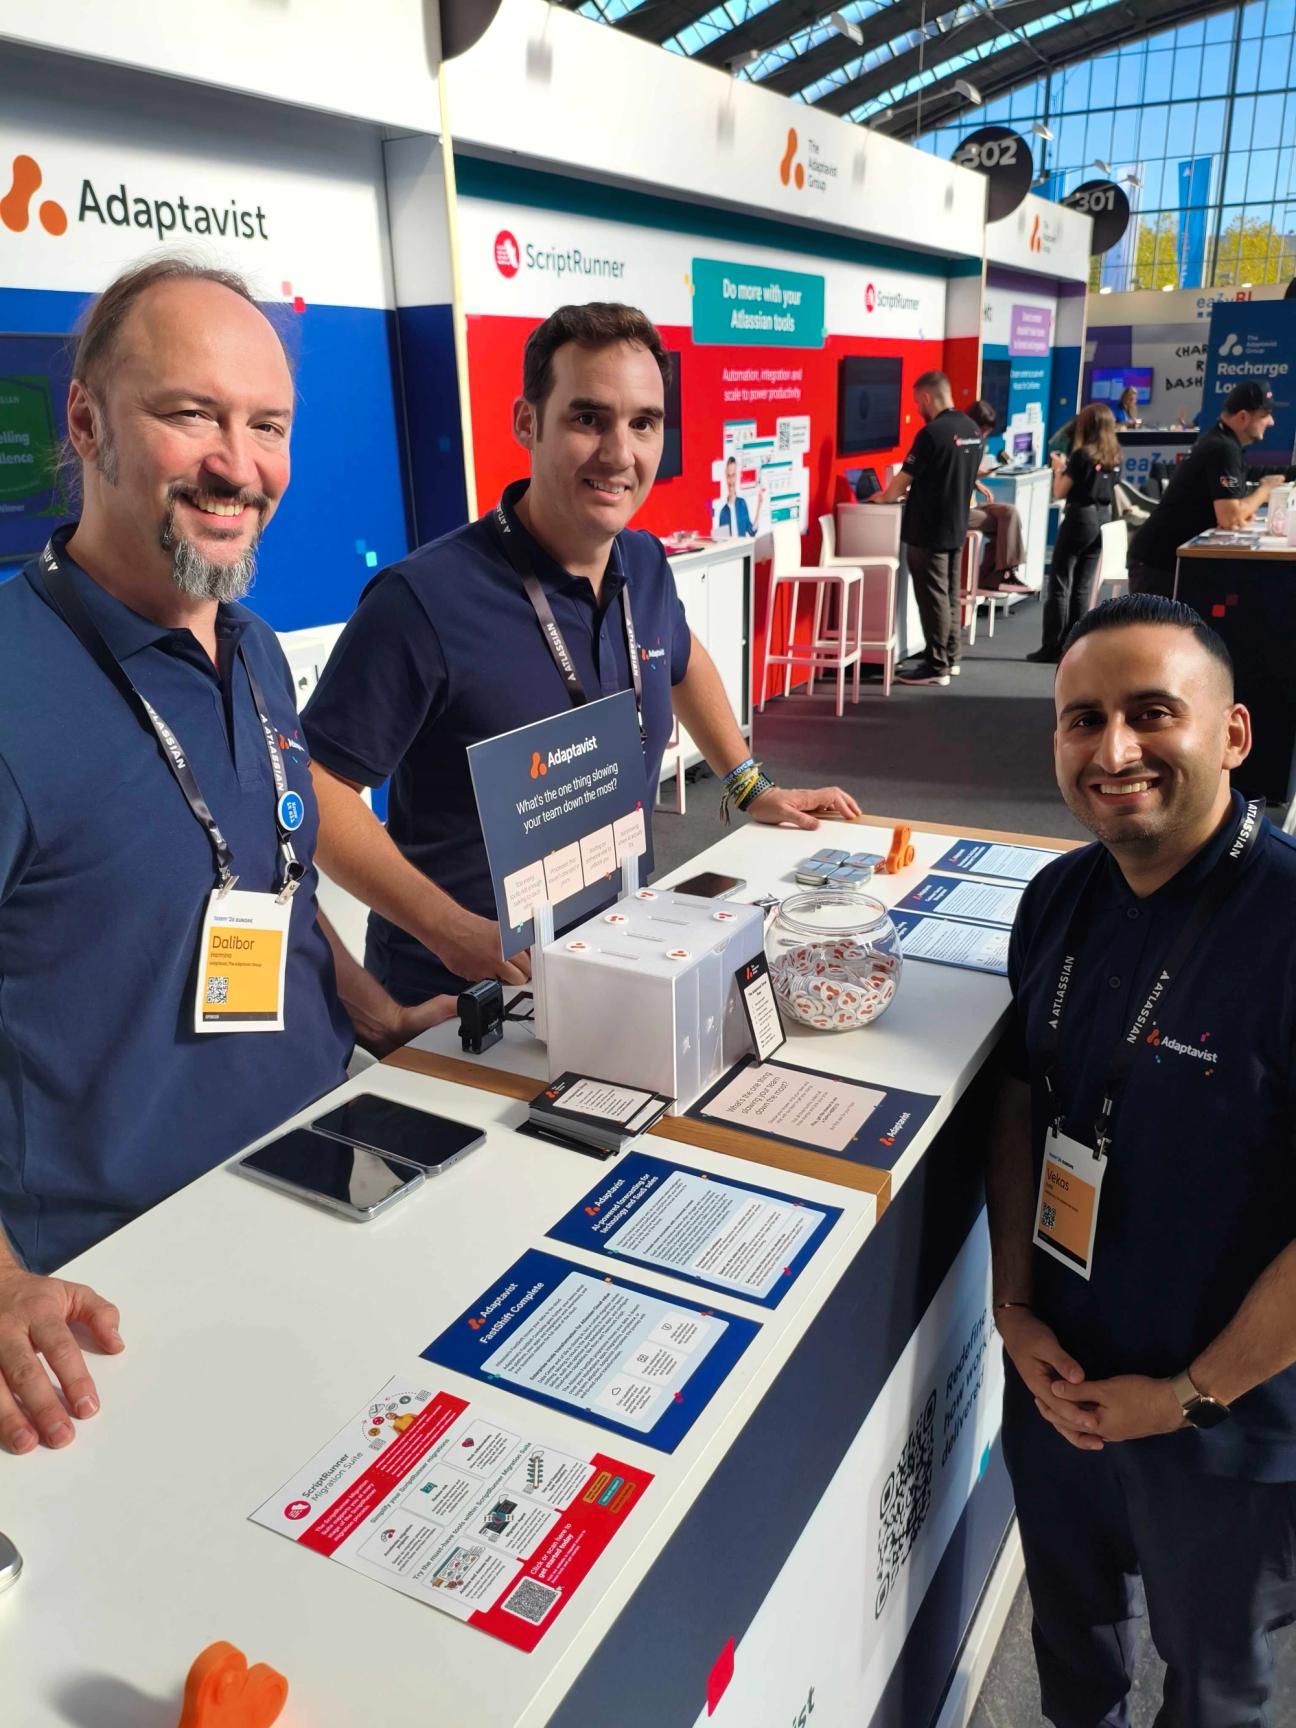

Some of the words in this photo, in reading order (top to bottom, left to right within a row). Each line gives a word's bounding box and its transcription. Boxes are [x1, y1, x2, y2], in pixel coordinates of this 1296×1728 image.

[955, 139, 1018, 169] 302
[78, 178, 269, 241] Adaptavist
[1076, 190, 1115, 212] 301
[526, 243, 625, 279] ScriptRunner
[723, 279, 735, 298] Do
[738, 284, 761, 301] more
[764, 285, 781, 303] with
[783, 289, 801, 308] your
[878, 291, 920, 311] ScriptRunner
[731, 310, 773, 331] Atlassian
[774, 311, 795, 332] tools
[1215, 381, 1235, 394] Lo
[1217, 362, 1289, 378] Recharge
[547, 623, 575, 671] ATLASSIAN
[627, 629, 639, 677] ATLASSIAN
[264, 726, 285, 792] ATLASSIAN
[546, 734, 598, 770] Adaptavist
[516, 793, 543, 816] What's
[543, 786, 557, 803] the
[557, 783, 571, 797] one
[572, 772, 591, 793] thing
[591, 760, 618, 784] slowing
[523, 815, 542, 834] your
[542, 805, 562, 823] team
[562, 793, 584, 813] down
[583, 787, 596, 803] the
[595, 777, 617, 797] most?
[1230, 802, 1258, 858] ATLASSIAN
[213, 935, 255, 950] Dalibor
[1051, 956, 1075, 1016] ATLASSIAN
[1126, 982, 1164, 1044] ATLASSIAN
[1161, 1036, 1218, 1063] Adaptavist
[725, 1098, 746, 1112] What's
[749, 1082, 762, 1091] one
[756, 1072, 774, 1083] thing
[740, 1097, 763, 1113] slowing
[756, 1087, 773, 1097] your
[765, 1076, 782, 1087] team
[753, 1102, 771, 1115] down
[885, 1111, 912, 1138] Adaptavist
[592, 1178, 627, 1206] Adaptavist
[1047, 1169, 1069, 1191] Vekas
[590, 1204, 621, 1231] AI-powered
[616, 1180, 645, 1205] forecasting
[598, 1207, 629, 1234] technology
[623, 1199, 636, 1208] and
[631, 1187, 648, 1199] SaaS
[643, 1176, 659, 1188] sales
[478, 1282, 519, 1317] Adaptavist
[478, 1312, 514, 1344] FastShift
[509, 1281, 545, 1313] Complete
[945, 1308, 987, 1400] Redefine
[944, 1382, 965, 1434] how
[966, 1332, 988, 1387] work
[941, 1361, 985, 1467] delivered
[301, 1453, 350, 1498] ScriptRunner
[310, 1468, 347, 1502] Migration
[342, 1451, 363, 1468] Suite
[369, 1502, 392, 1524] Simplify
[388, 1491, 402, 1503] your
[398, 1461, 429, 1492] ScriptRunner
[425, 1438, 451, 1462] migrations
[315, 1523, 327, 1532] The
[323, 1497, 351, 1524] ScriptRunner
[348, 1478, 369, 1498] Migration
[321, 1523, 335, 1535] Suite
[331, 1505, 352, 1524] supports
[348, 1497, 360, 1506] you
[360, 1481, 375, 1494] every
[327, 1525, 342, 1538] stage
[343, 1513, 354, 1521] the
[350, 1487, 378, 1514] ScriptRunner
[413, 1570, 424, 1580] Try
[420, 1561, 432, 1571] the
[428, 1533, 455, 1561] must-have
[451, 1521, 466, 1534] tools
[462, 1505, 479, 1521] within
[475, 1475, 504, 1505] ScriptRunner
[501, 1453, 523, 1475] Migration
[519, 1441, 532, 1454] Suite
[530, 1560, 544, 1574] Click
[540, 1553, 549, 1561] or
[545, 1540, 559, 1554] scan
[555, 1528, 568, 1541] here
[537, 1568, 548, 1578] get
[544, 1548, 563, 1568] started
[558, 1533, 574, 1549] today
